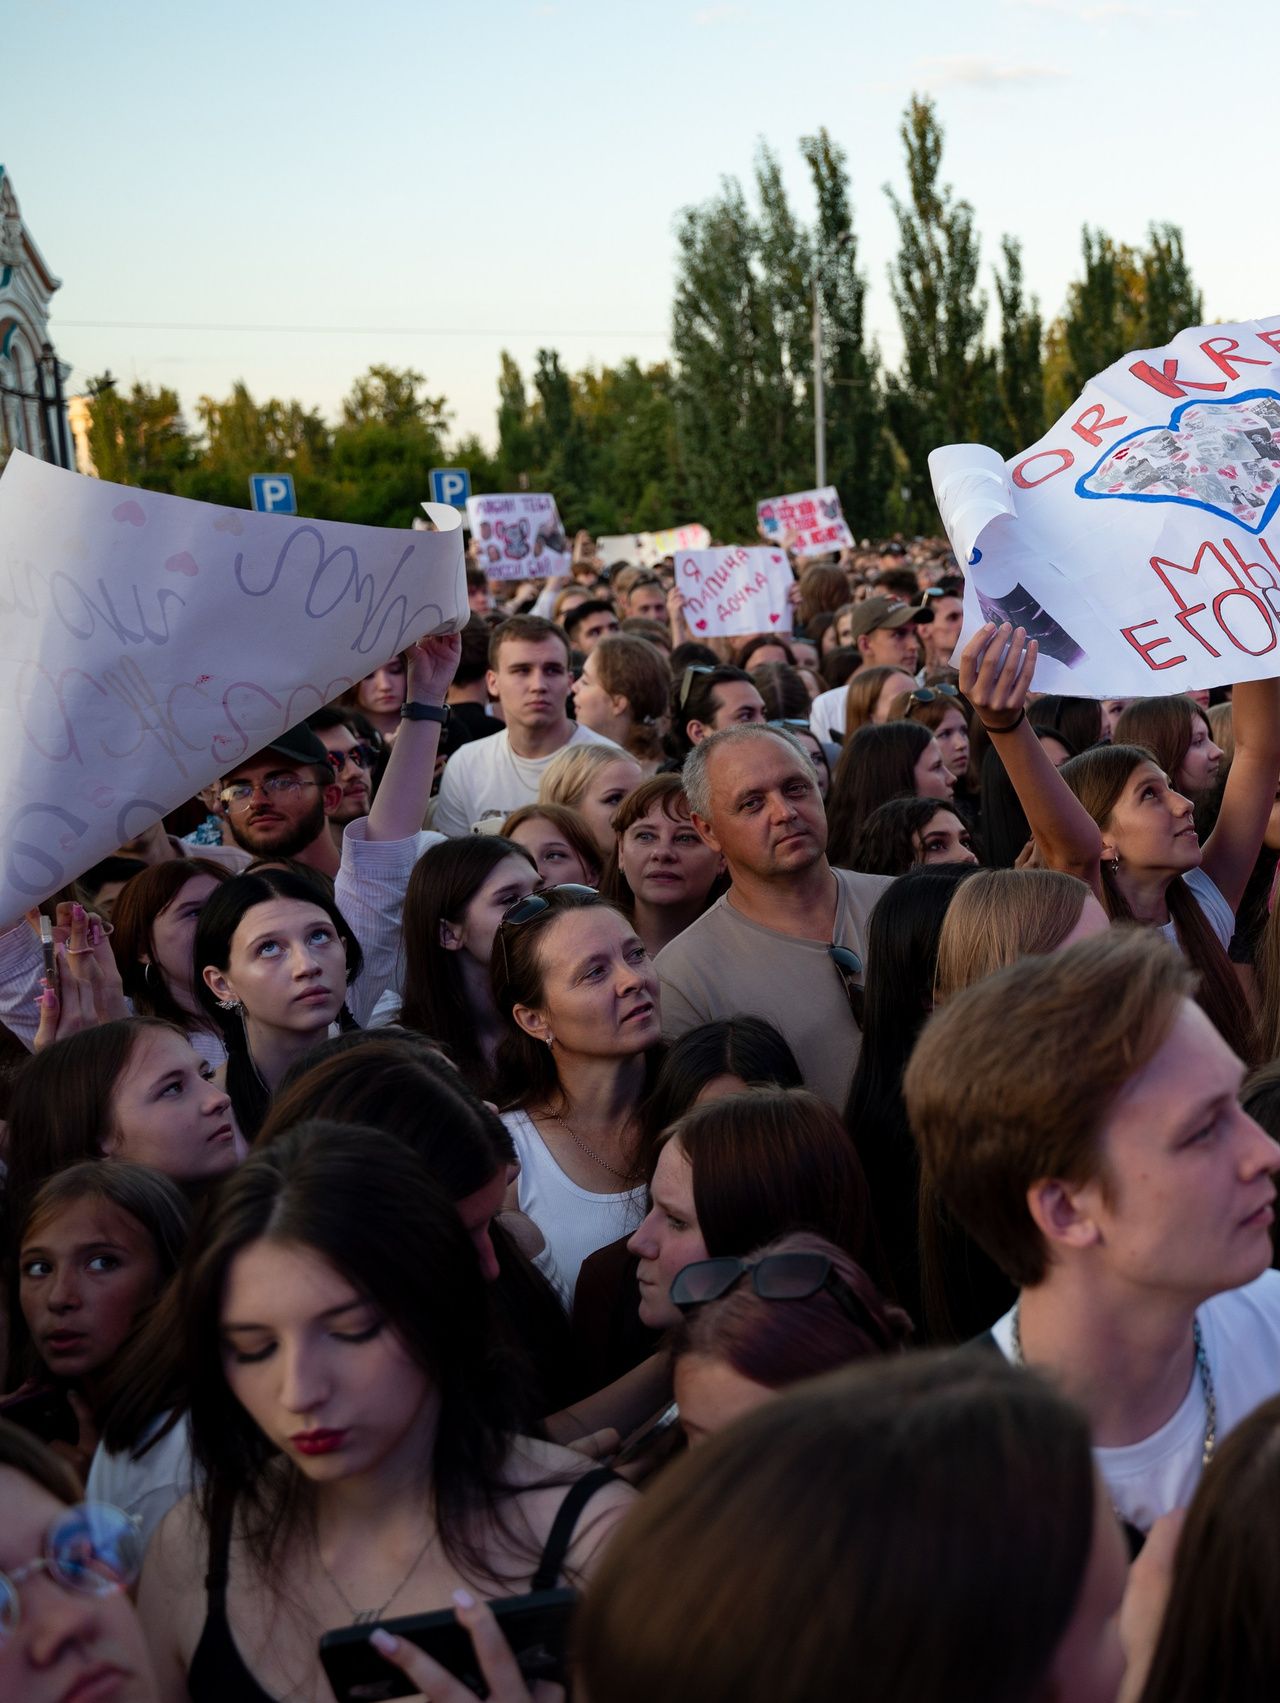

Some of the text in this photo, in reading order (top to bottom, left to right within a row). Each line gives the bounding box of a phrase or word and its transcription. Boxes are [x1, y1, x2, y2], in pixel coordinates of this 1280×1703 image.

[262, 479, 287, 512] P
[441, 474, 464, 504] P
[682, 558, 703, 583] Я
[685, 548, 750, 614] ПАПИНА
[716, 571, 769, 623] ДОЧКА
